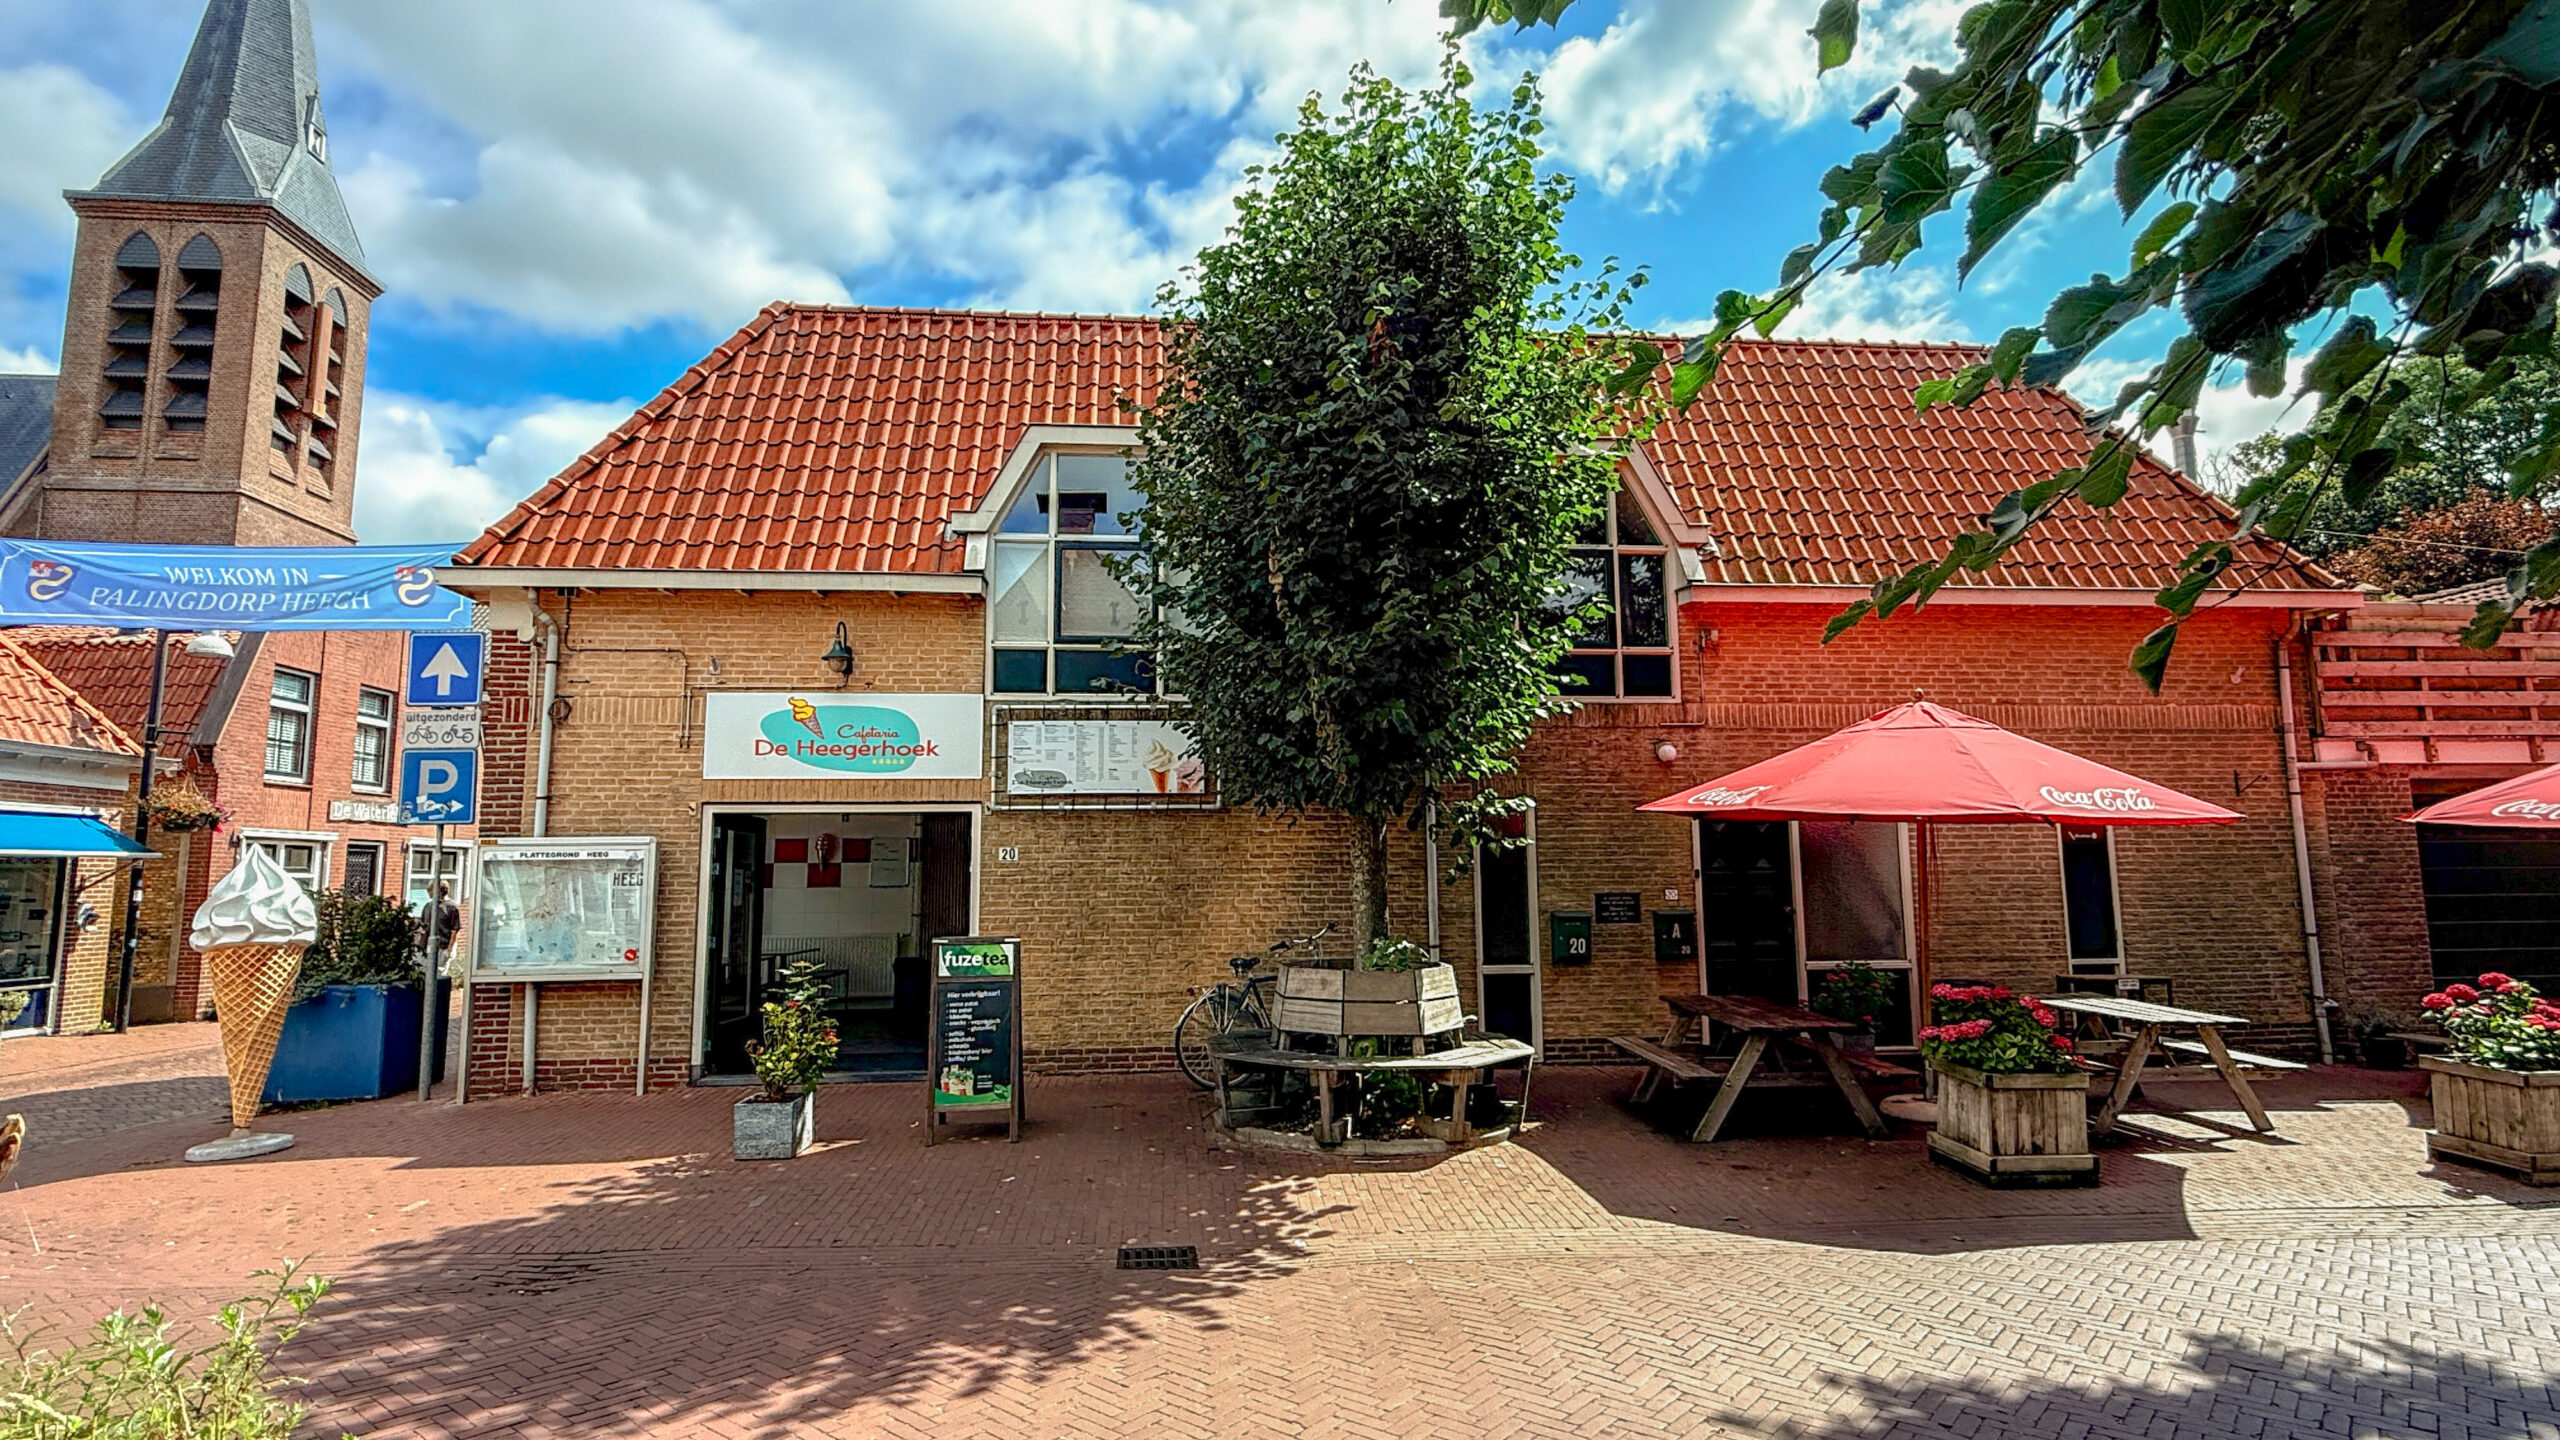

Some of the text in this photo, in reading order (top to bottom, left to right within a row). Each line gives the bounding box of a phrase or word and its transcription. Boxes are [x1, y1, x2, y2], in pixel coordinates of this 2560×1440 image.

[164, 567, 309, 586] WELKOM IN
[89, 587, 275, 611] PALINGDORP
[406, 712, 476, 724] uitgezonderd
[837, 724, 899, 743] Cafetaria
[754, 739, 940, 760] De Heegerhoek
[417, 759, 459, 814] P
[2040, 786, 2156, 812] Coca-Cola
[333, 802, 351, 817] De
[1001, 847, 1016, 860] 20
[613, 872, 644, 887] HEEG
[1666, 889, 1677, 899] 20
[1671, 923, 1681, 938] A
[1569, 938, 1586, 954] 20
[944, 951, 1009, 967] fuzetea
